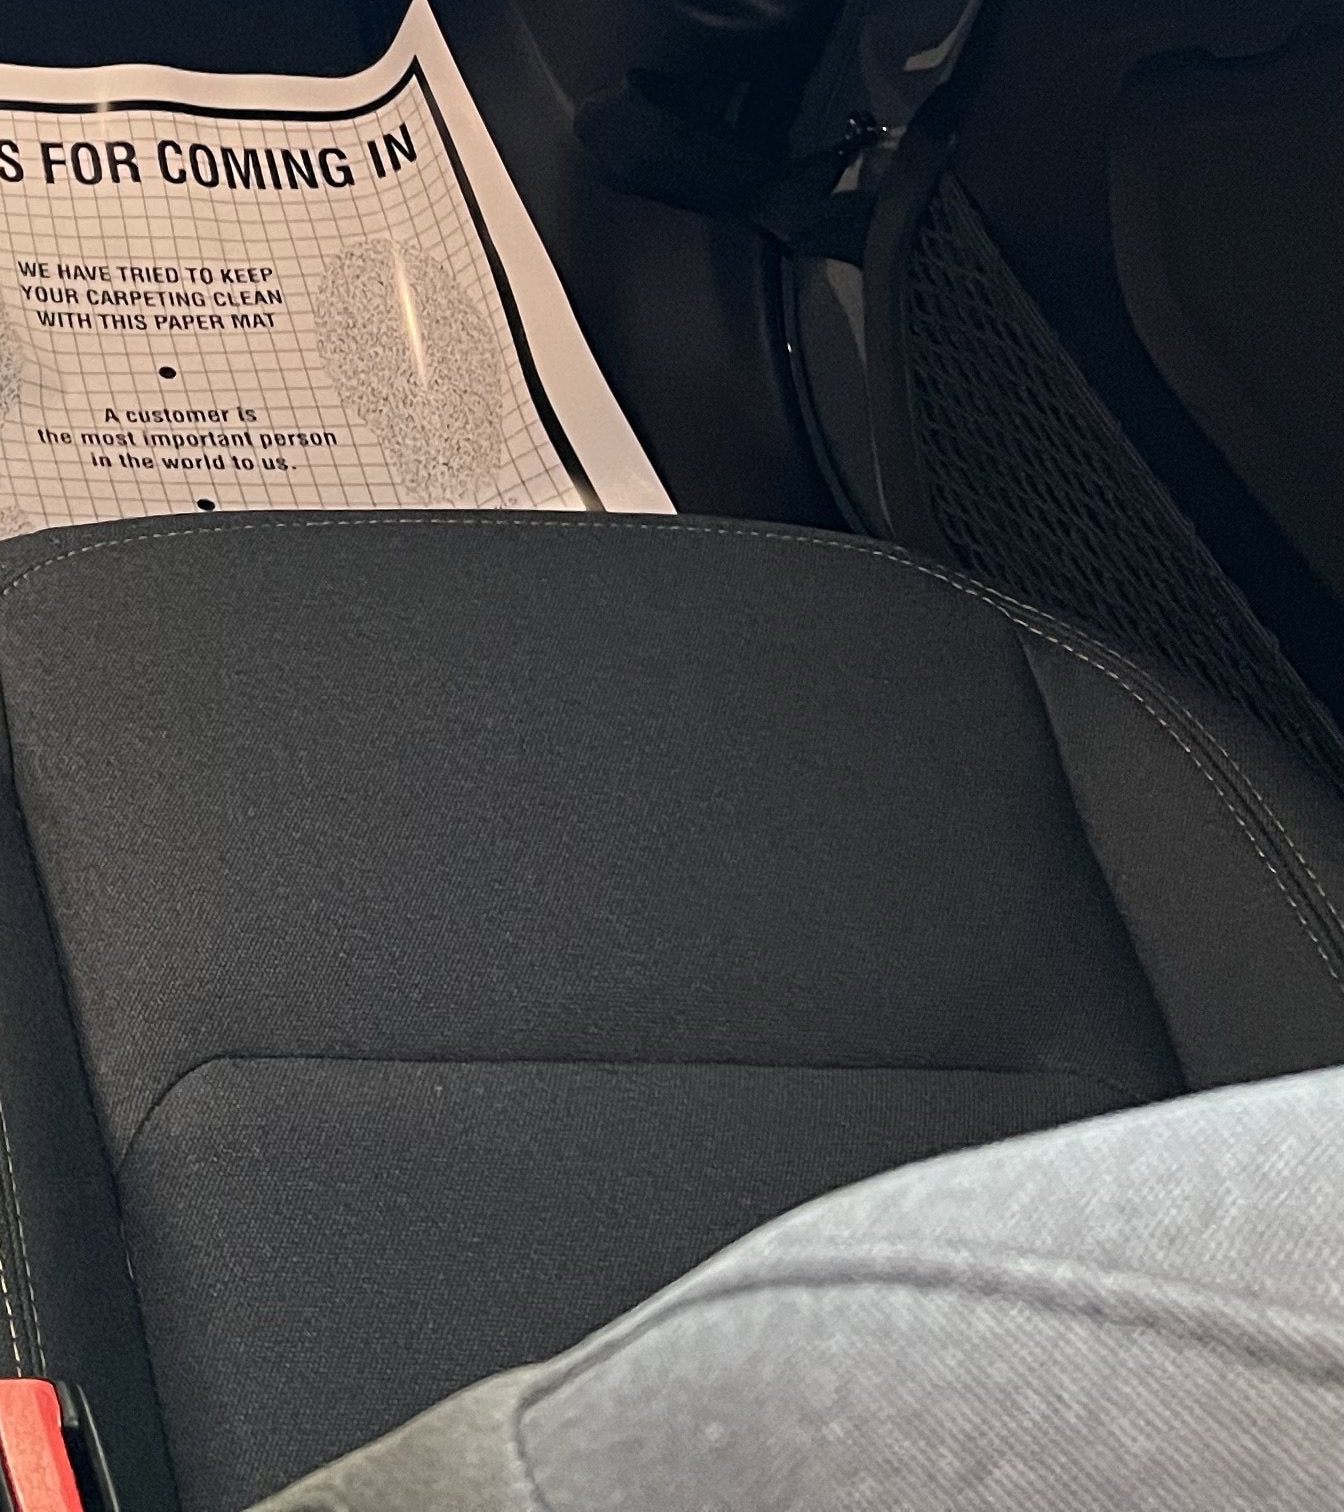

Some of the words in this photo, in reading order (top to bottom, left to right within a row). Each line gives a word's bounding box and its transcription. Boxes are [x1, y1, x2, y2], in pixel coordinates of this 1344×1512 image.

[40, 141, 141, 185] FOR
[157, 139, 355, 190] COMING
[367, 122, 417, 178] IN
[18, 261, 50, 279] WE
[57, 264, 112, 281] HAVE
[116, 266, 179, 283] TRIED
[185, 268, 213, 285] TO
[220, 268, 273, 283] KEEP
[20, 285, 79, 304] YOUR
[86, 290, 206, 307] CARPETING
[213, 289, 283, 307] CLEAN
[36, 311, 92, 329] WITH
[98, 313, 148, 330] THIS
[154, 314, 225, 330] PAPER
[231, 312, 277, 329] MAT
[104, 408, 120, 423] A
[126, 408, 229, 423] customer
[238, 406, 257, 422] is
[38, 429, 72, 444] the
[81, 430, 136, 445] most
[142, 430, 253, 449] important
[259, 431, 337, 449] person
[91, 452, 112, 467] in
[119, 453, 154, 469] the
[162, 454, 225, 470] world
[232, 455, 254, 470] to
[262, 456, 297, 471] us.
